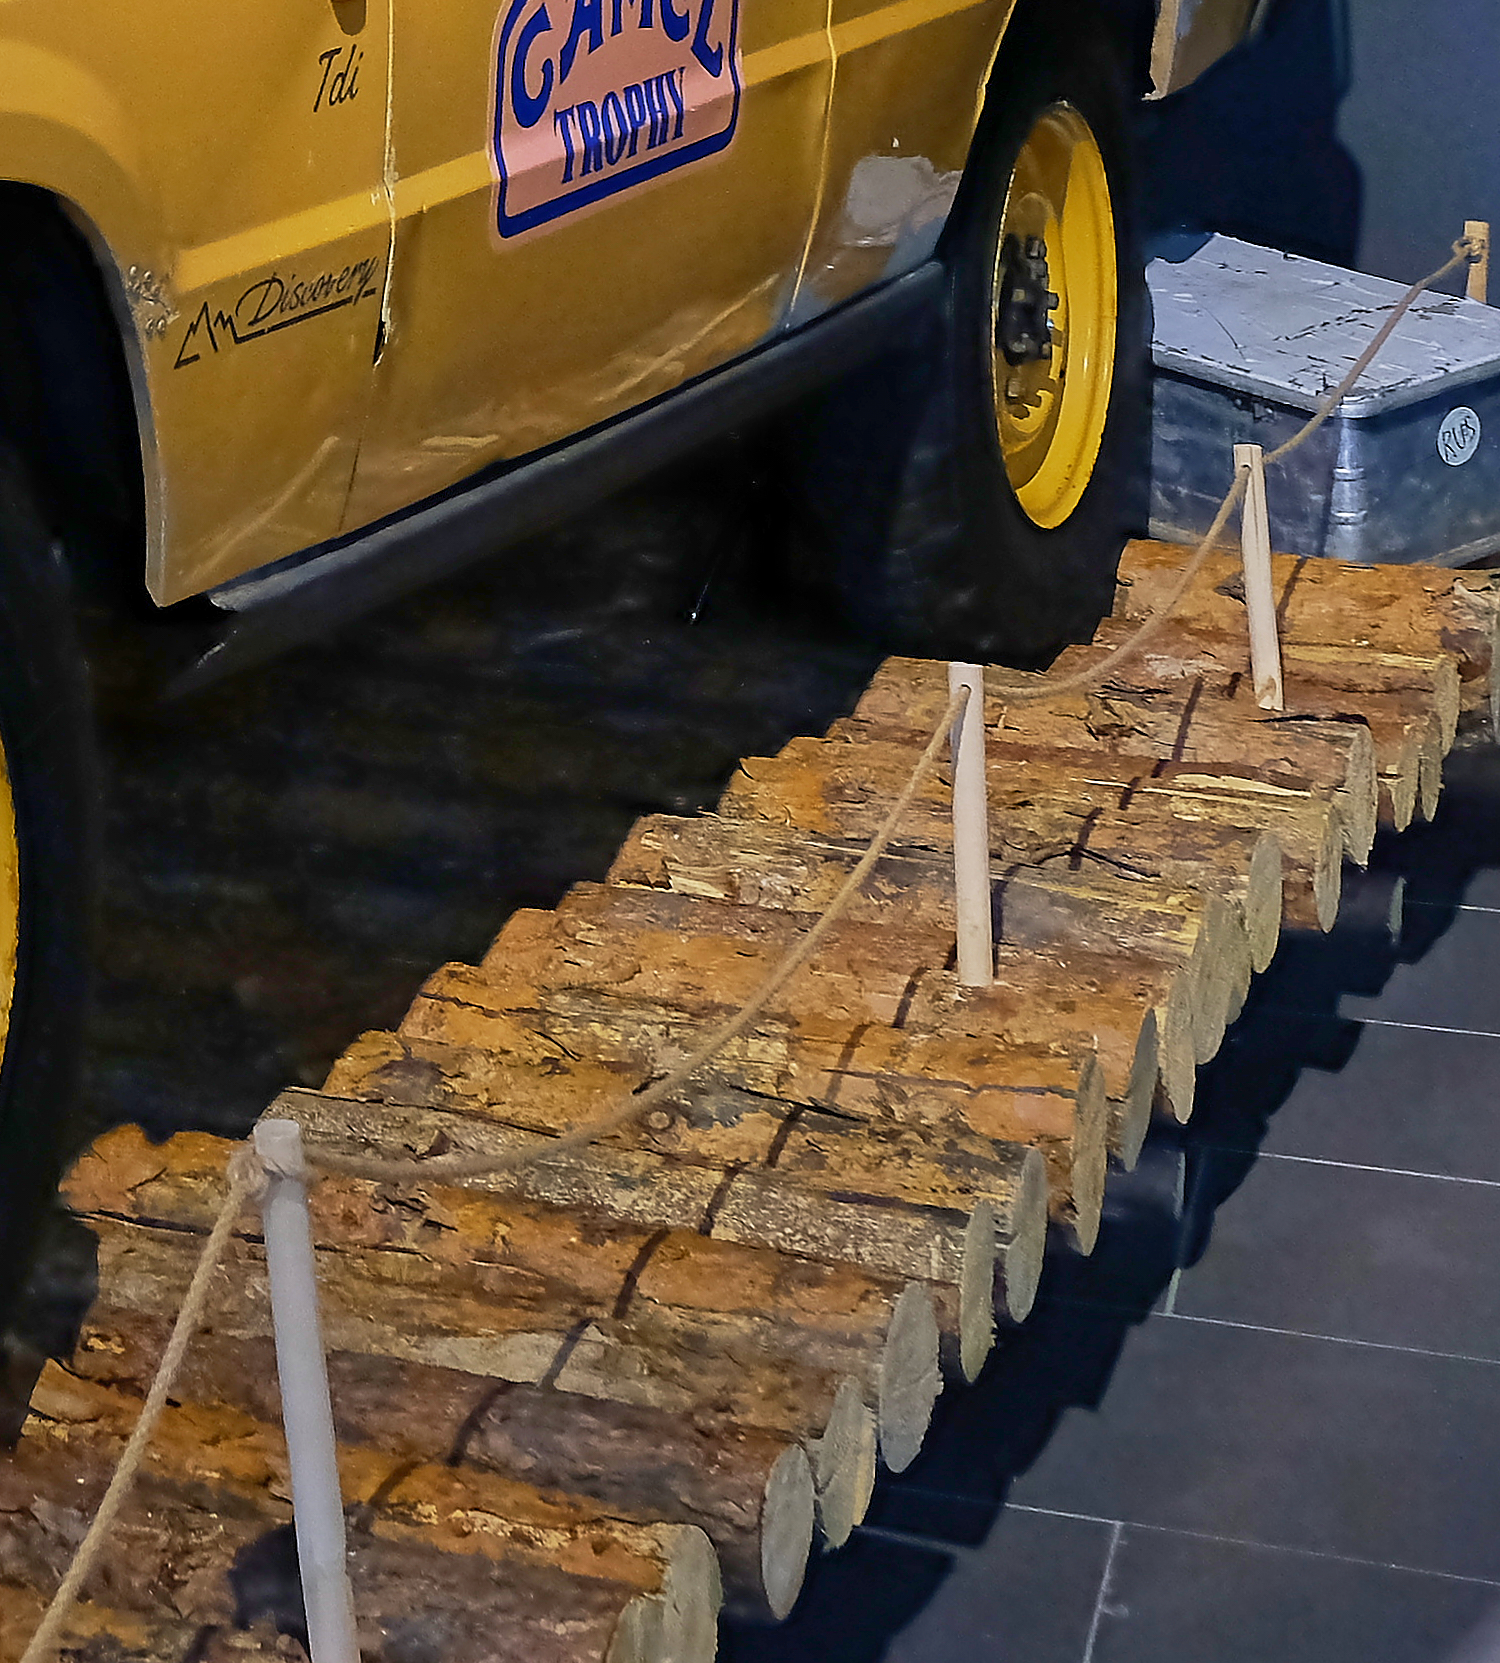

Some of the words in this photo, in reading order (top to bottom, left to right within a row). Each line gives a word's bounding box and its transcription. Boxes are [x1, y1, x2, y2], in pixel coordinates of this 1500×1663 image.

[313, 43, 364, 113] Tdi
[554, 67, 686, 184] TROPHY
[234, 256, 380, 327] Discovery
